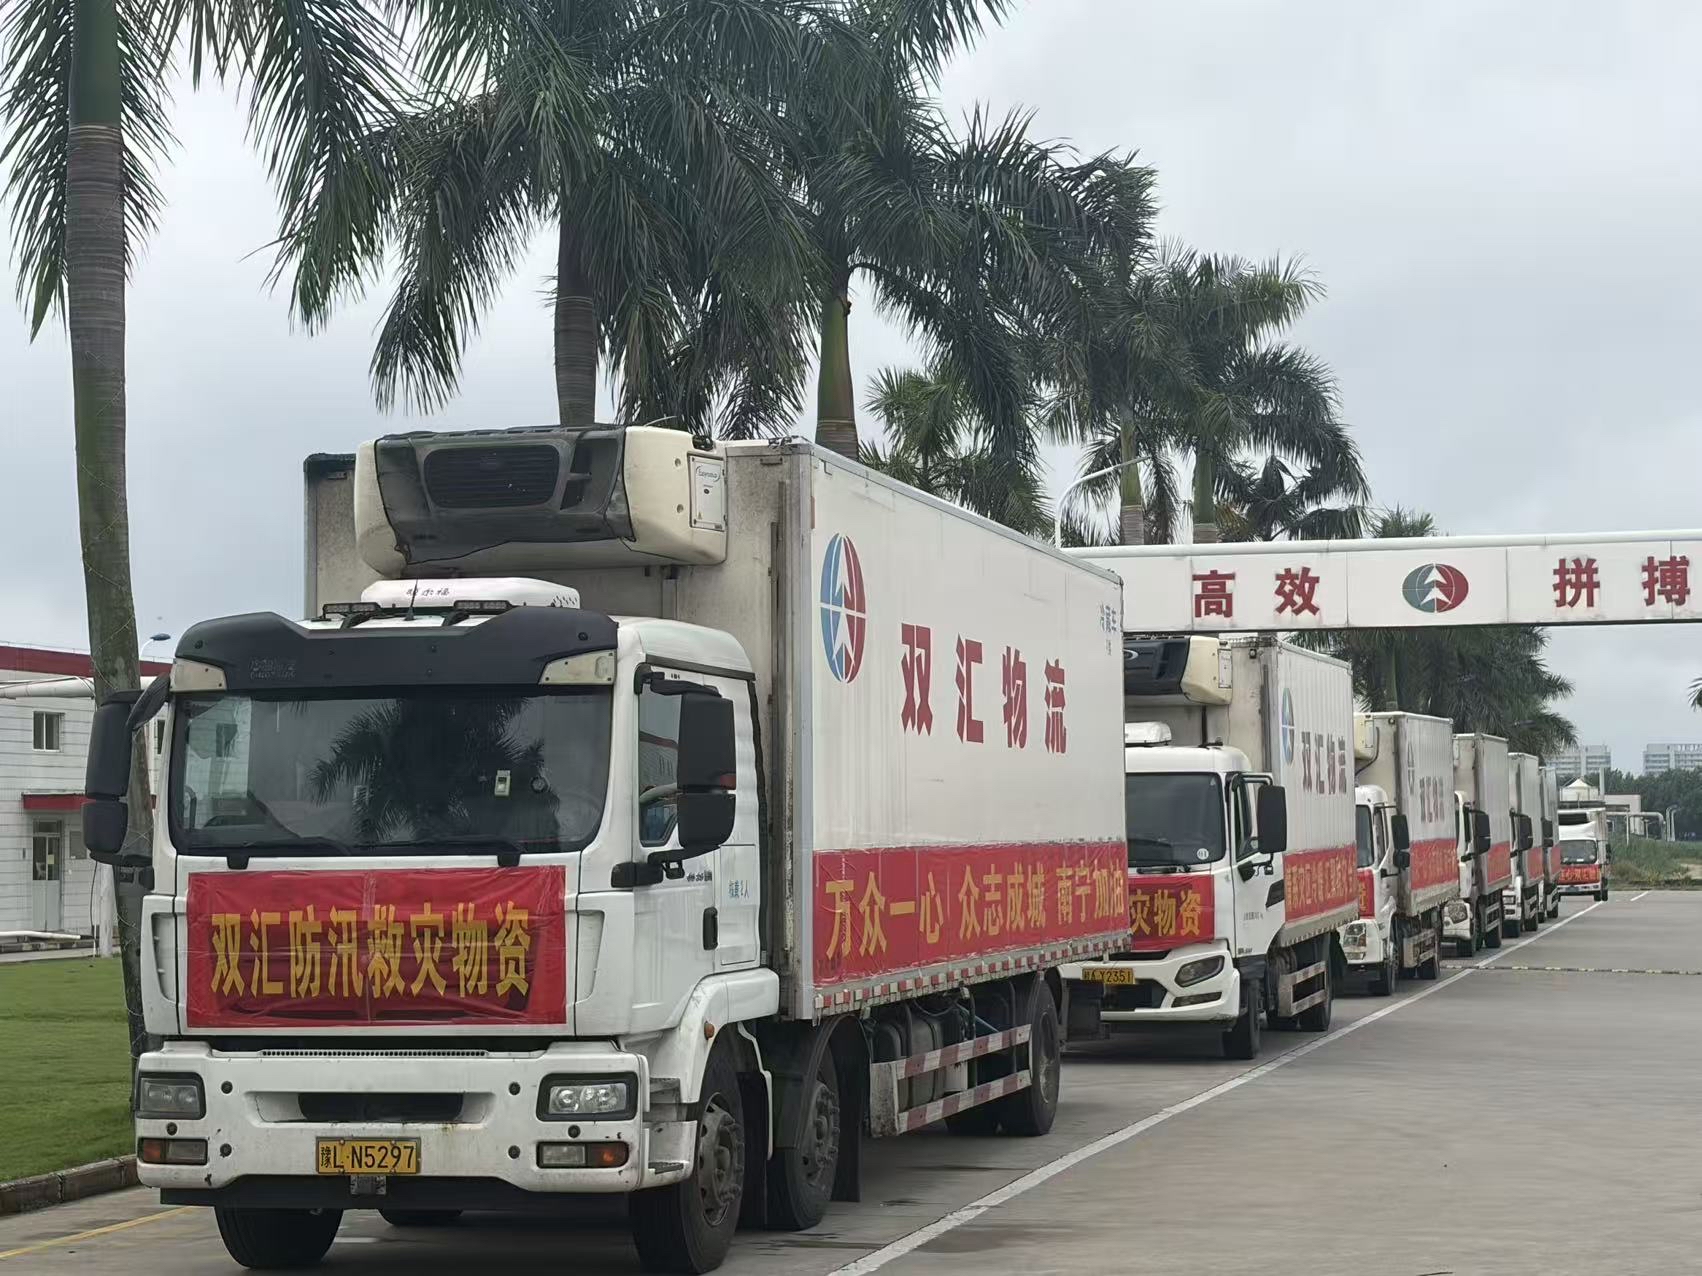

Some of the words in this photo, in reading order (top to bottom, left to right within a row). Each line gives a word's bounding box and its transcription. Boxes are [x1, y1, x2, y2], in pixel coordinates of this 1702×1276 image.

[1192, 567, 1321, 619] 高效
[1553, 556, 1691, 608] 拼搏
[900, 622, 1067, 754] 双汇物流
[1300, 731, 1347, 795] 双汇物流
[210, 900, 531, 998] 双汇防汛救灾物资
[825, 871, 945, 960] 万众一心
[958, 862, 1046, 941] 众志成城
[1056, 859, 1125, 925] 南宁加油
[1128, 888, 1201, 936] 灾物资
